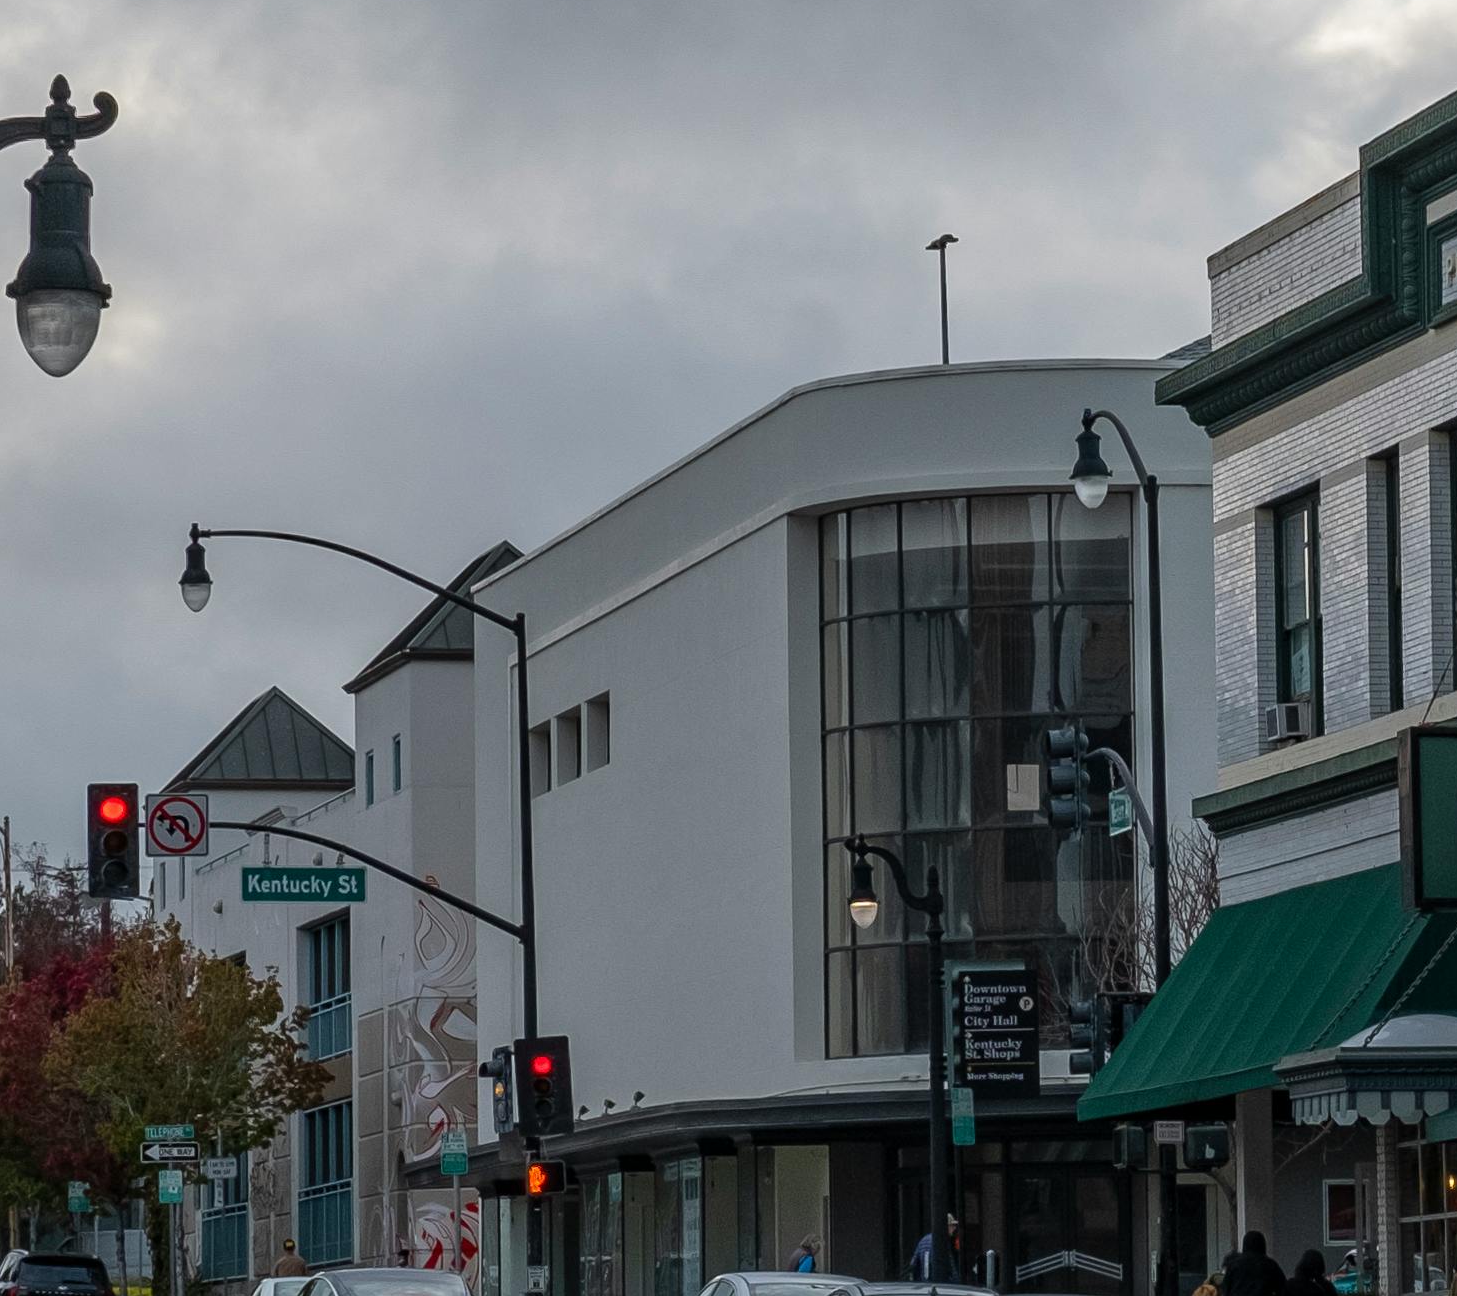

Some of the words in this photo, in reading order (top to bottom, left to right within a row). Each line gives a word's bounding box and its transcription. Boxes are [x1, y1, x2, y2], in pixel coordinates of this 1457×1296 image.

[247, 873, 333, 898] Kentucky
[337, 874, 358, 895] St
[964, 984, 1027, 994] Downtown
[964, 994, 1006, 1007] Garage
[964, 1016, 990, 1028] City
[992, 1015, 1018, 1026] Hall
[965, 1038, 1023, 1051] Kentucky
[982, 1049, 1021, 1061] Shops
[158, 1148, 174, 1156] ONE
[176, 1148, 193, 1156] WAY
